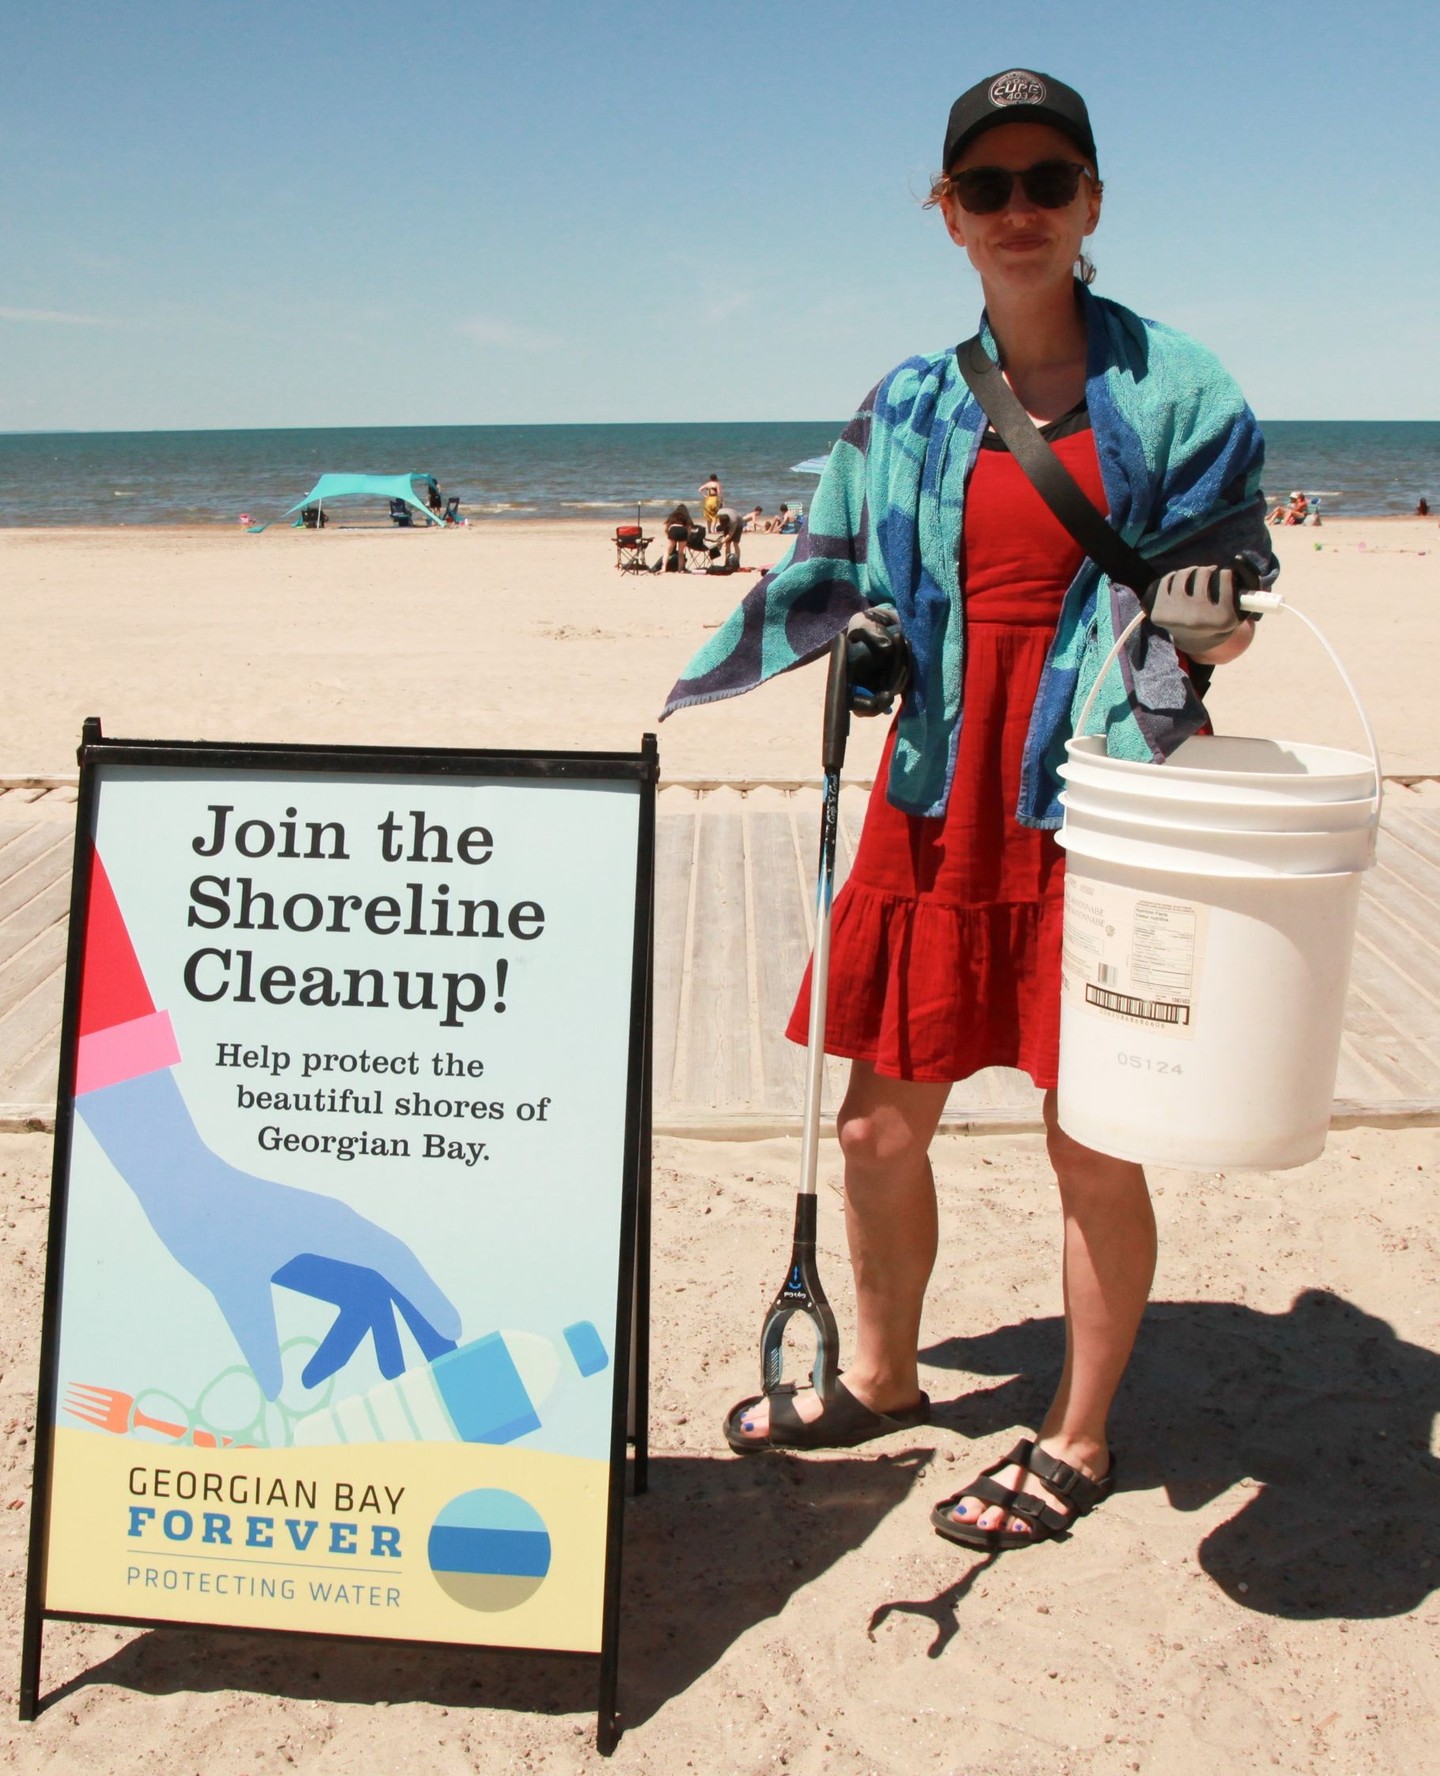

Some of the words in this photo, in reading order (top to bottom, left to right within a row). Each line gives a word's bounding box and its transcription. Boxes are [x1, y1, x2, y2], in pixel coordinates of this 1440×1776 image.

[993, 83, 1040, 96] CUPE
[1006, 92, 1028, 101] 403
[192, 805, 350, 860] Join
[378, 811, 494, 865] the
[188, 875, 546, 940] Shoreline
[183, 948, 509, 1027] Cleanup!
[215, 1043, 291, 1076] Help
[302, 1048, 420, 1078] protect
[431, 1052, 485, 1078] the
[1117, 1052, 1184, 1076] 05124
[237, 1085, 384, 1116] beautiful
[395, 1092, 504, 1120] shores
[516, 1097, 551, 1121] of
[258, 1127, 411, 1161] Georgian
[422, 1134, 489, 1166] Bay.
[129, 1467, 316, 1510] GEORGIAN
[335, 1483, 405, 1515] BAY
[128, 1506, 402, 1558] FOREVER
[128, 1567, 295, 1600] PROTECTING
[309, 1582, 400, 1608] WATER
